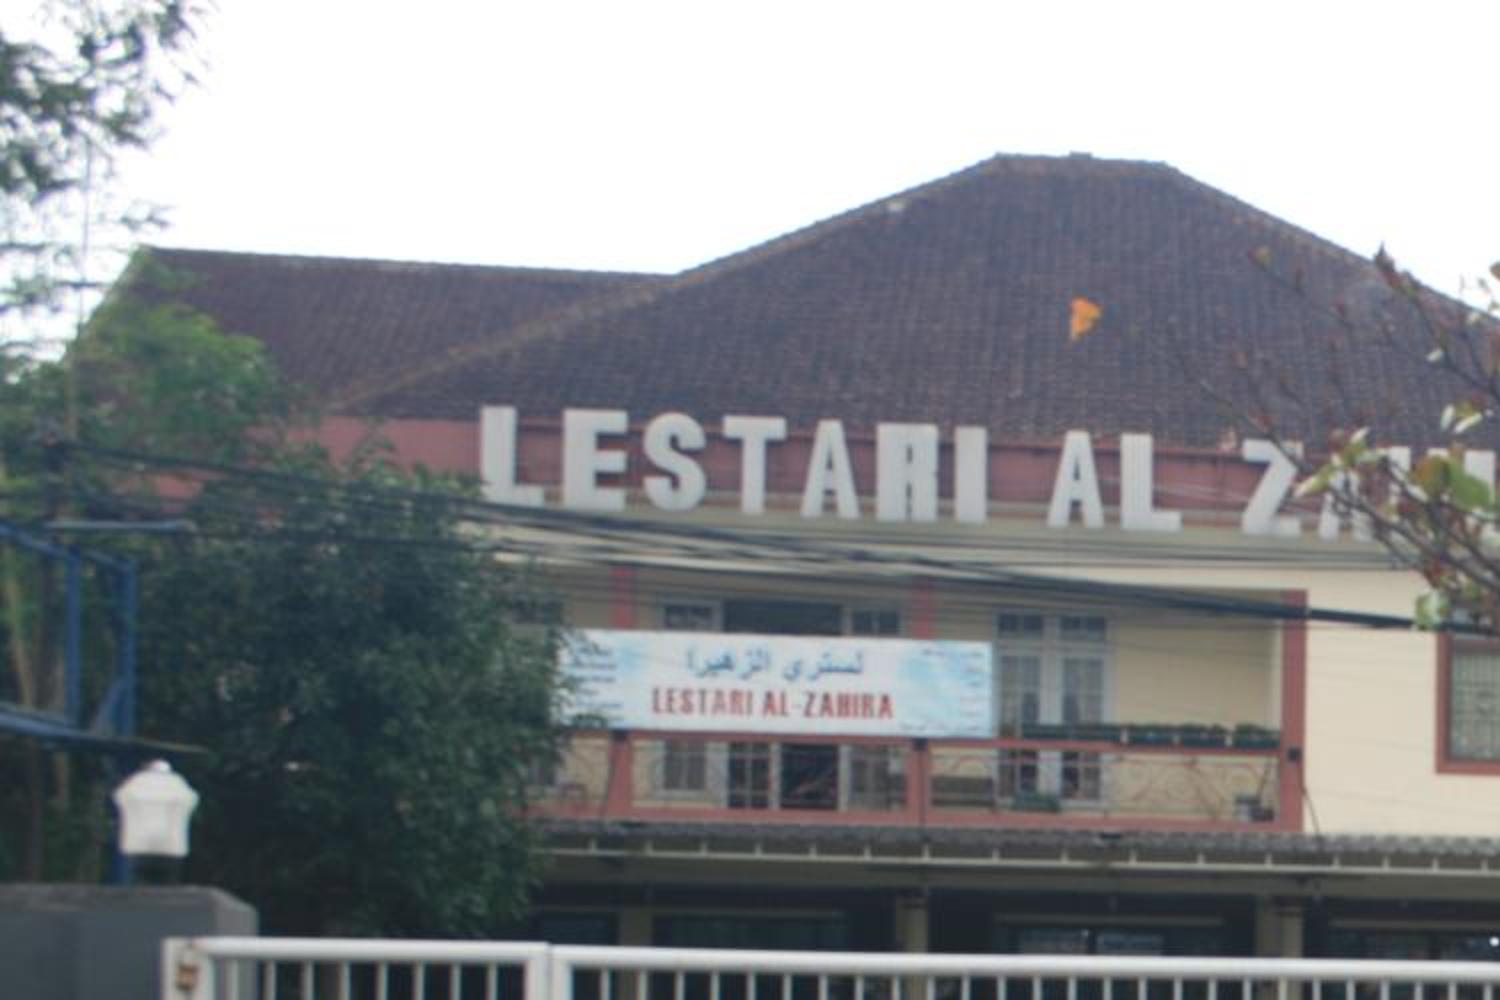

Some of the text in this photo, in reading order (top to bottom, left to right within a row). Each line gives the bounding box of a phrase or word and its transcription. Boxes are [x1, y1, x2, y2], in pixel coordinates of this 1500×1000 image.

[480, 404, 989, 524] LESTARI
[1047, 429, 1183, 533] AL
[650, 686, 754, 717] LESTARI
